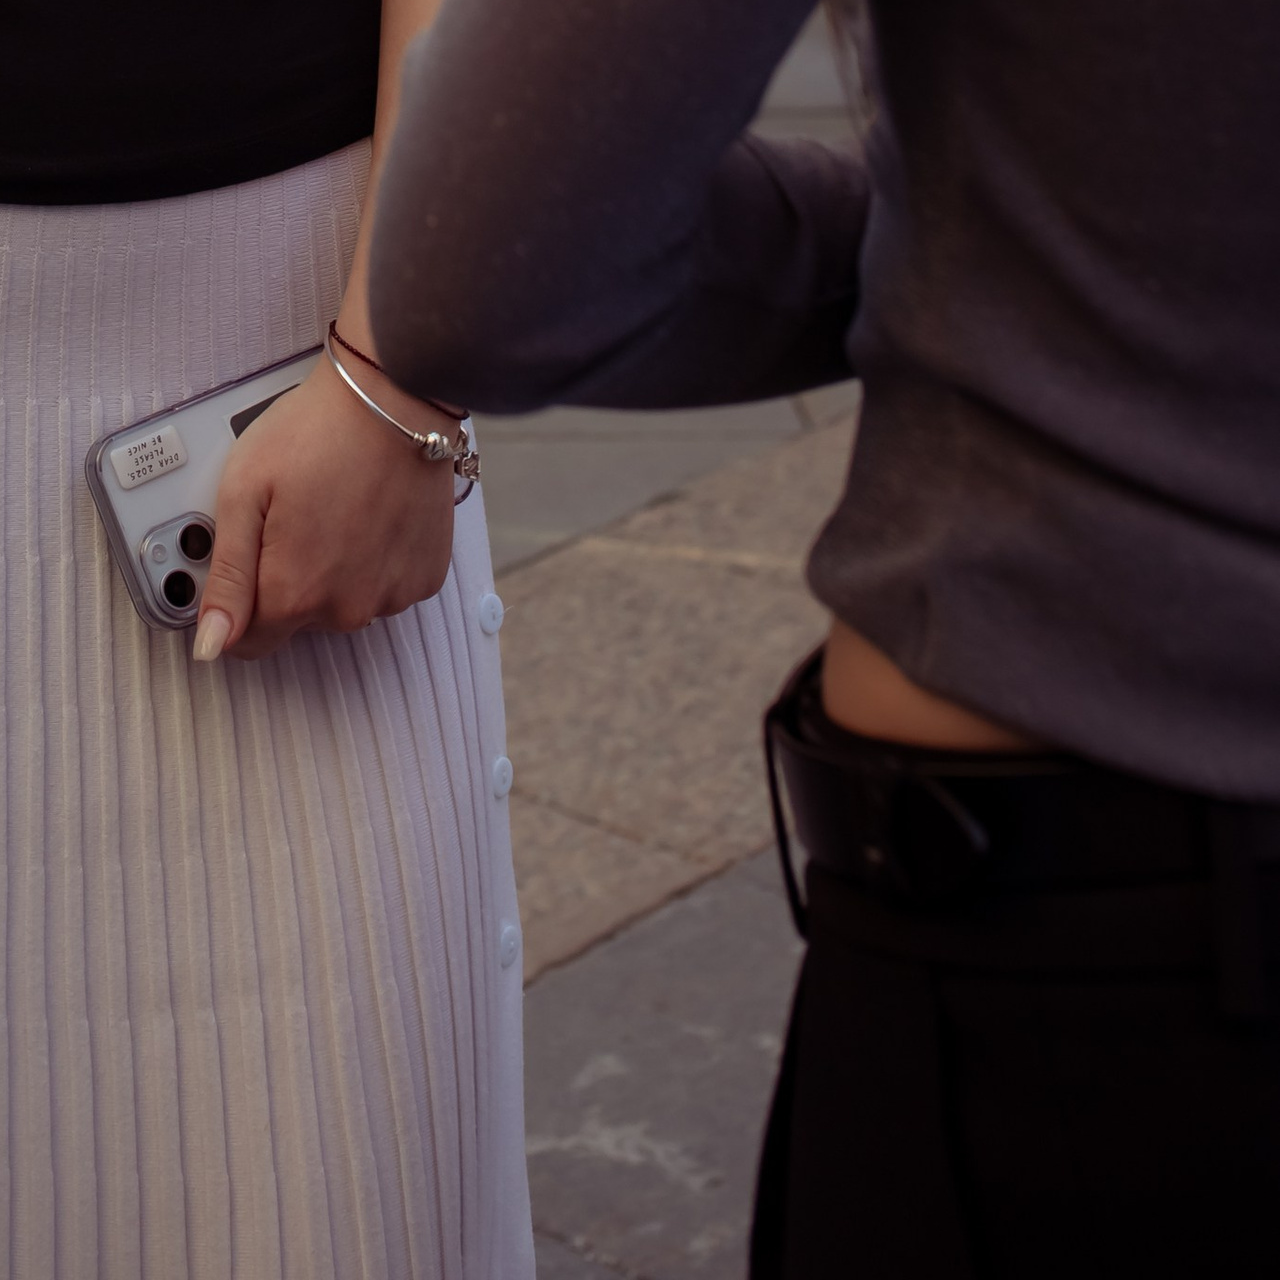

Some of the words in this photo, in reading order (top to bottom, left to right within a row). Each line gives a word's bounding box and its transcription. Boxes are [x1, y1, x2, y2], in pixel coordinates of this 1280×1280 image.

[152, 435, 162, 446] BE
[128, 442, 147, 456] NICE
[135, 447, 164, 466] PLEASE
[158, 453, 179, 467] DEAR
[128, 465, 153, 481] 2025,
